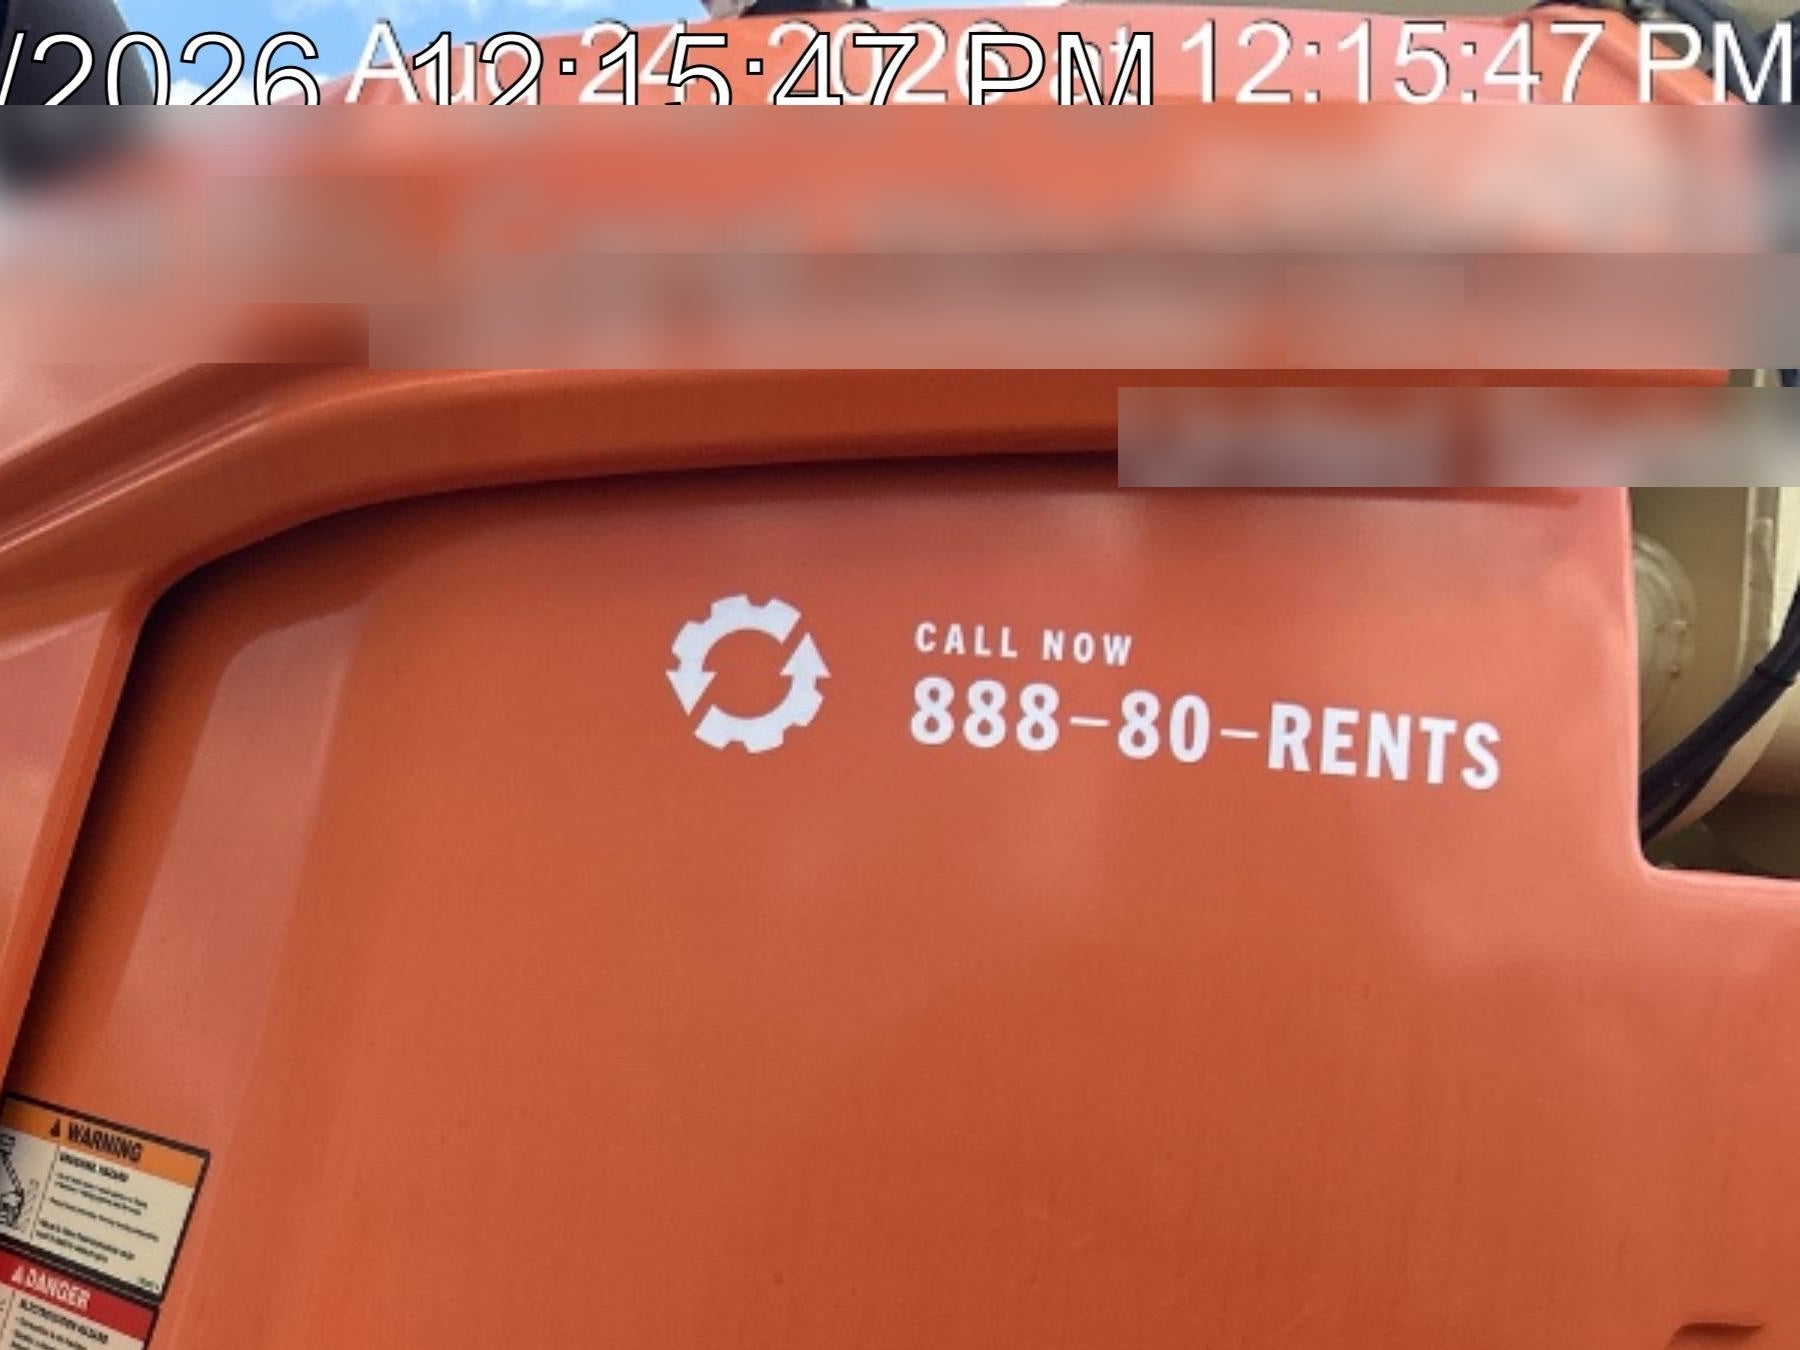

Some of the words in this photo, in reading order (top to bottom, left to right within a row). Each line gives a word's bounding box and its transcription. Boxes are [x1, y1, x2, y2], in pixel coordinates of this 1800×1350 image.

[914, 621, 1019, 658] CALL
[1042, 629, 1134, 667] NOW
[910, 675, 1503, 790] 888-80-RENTS
[67, 1120, 143, 1162] WARNING
[24, 1267, 91, 1313] DANGER
